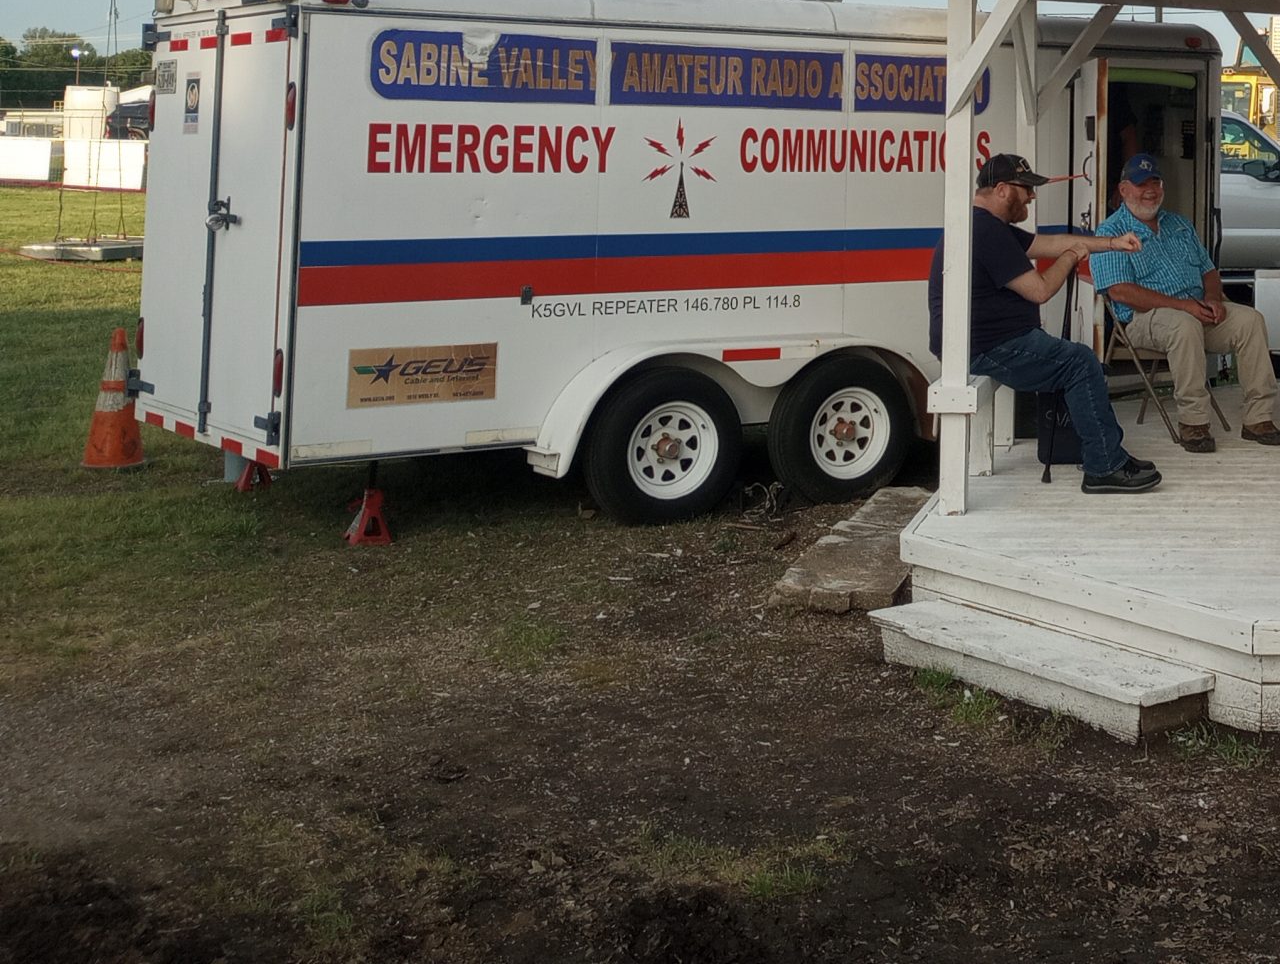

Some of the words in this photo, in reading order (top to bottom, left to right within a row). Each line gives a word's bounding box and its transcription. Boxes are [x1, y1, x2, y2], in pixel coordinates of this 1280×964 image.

[498, 46, 615, 91] VALLEY
[622, 51, 743, 97] AMATEUR
[752, 56, 824, 98] RADIO
[366, 122, 617, 174] EMERGENCY
[740, 127, 991, 174] COMMUNICATIS
[531, 301, 586, 319] K5GVL
[592, 298, 679, 316] REPEATER
[683, 296, 739, 312] 146.780
[743, 296, 761, 310] PL
[766, 294, 801, 309] 114.8
[399, 355, 490, 376] GEUS
